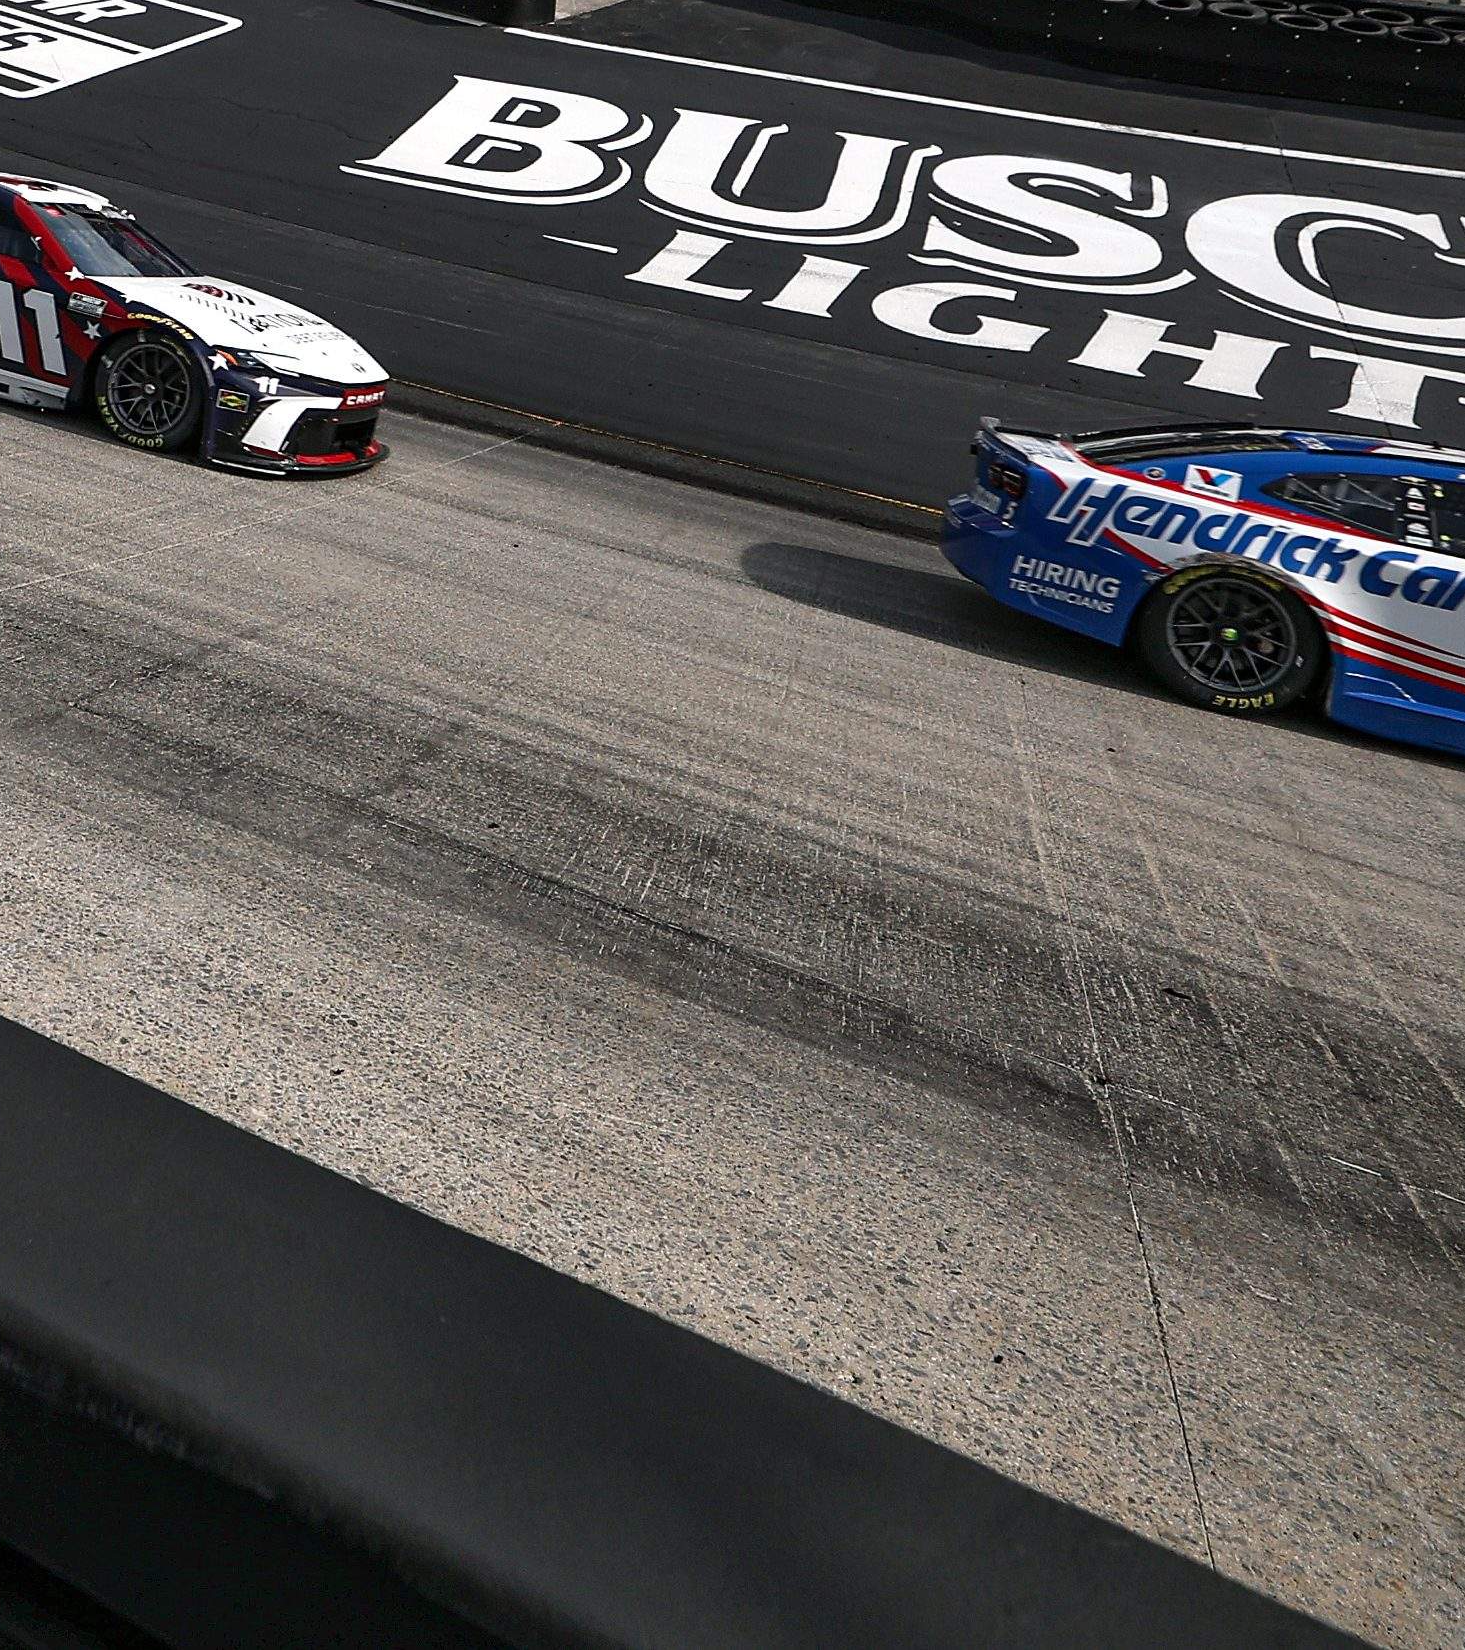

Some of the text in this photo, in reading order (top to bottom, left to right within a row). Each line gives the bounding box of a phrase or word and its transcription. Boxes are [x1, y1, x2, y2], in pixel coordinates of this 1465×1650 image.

[127, 311, 194, 341] GOODYEAR
[255, 375, 280, 395] 11
[345, 390, 387, 406] CAMRY
[1010, 554, 1122, 599] HIRING
[1008, 577, 1115, 615] TECHNICIANS
[1211, 692, 1276, 710] EAGLE
